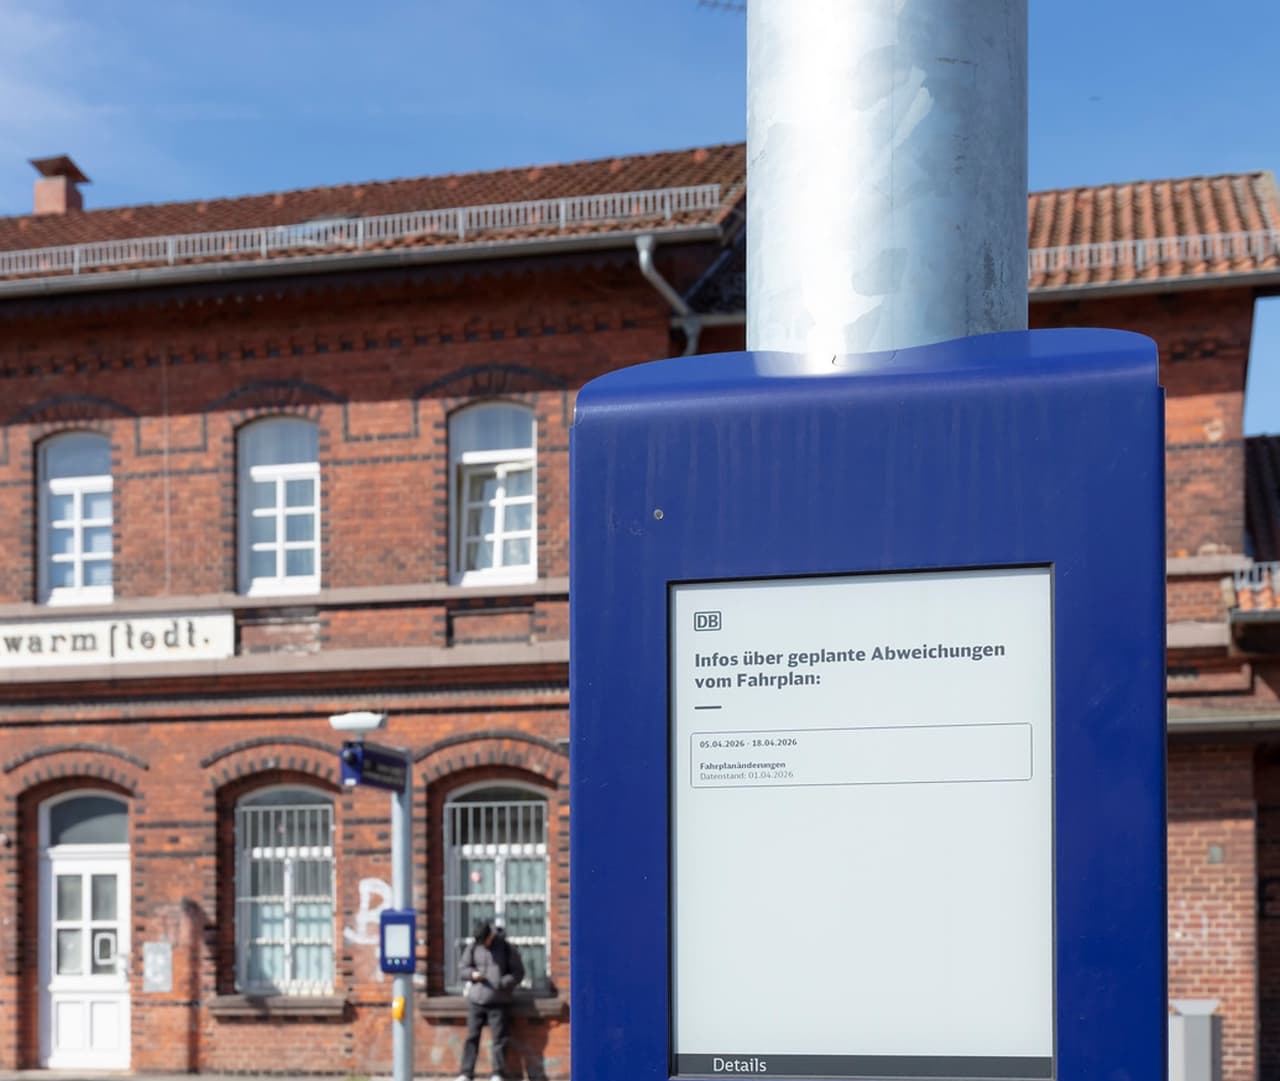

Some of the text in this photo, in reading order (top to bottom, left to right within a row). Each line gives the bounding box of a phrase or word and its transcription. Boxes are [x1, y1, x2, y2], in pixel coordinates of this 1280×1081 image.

[695, 611, 720, 630] DB
[695, 642, 1006, 668] Infos über geplante Abweichungen
[695, 672, 821, 689] vom Fahrplan:
[699, 740, 745, 748] 05.04.2026
[752, 738, 798, 747] 18.04.2026
[700, 762, 786, 770] Fahrplanänderungen
[700, 771, 794, 780] Datenstand: 01.04.2026
[713, 1058, 767, 1072] Details
